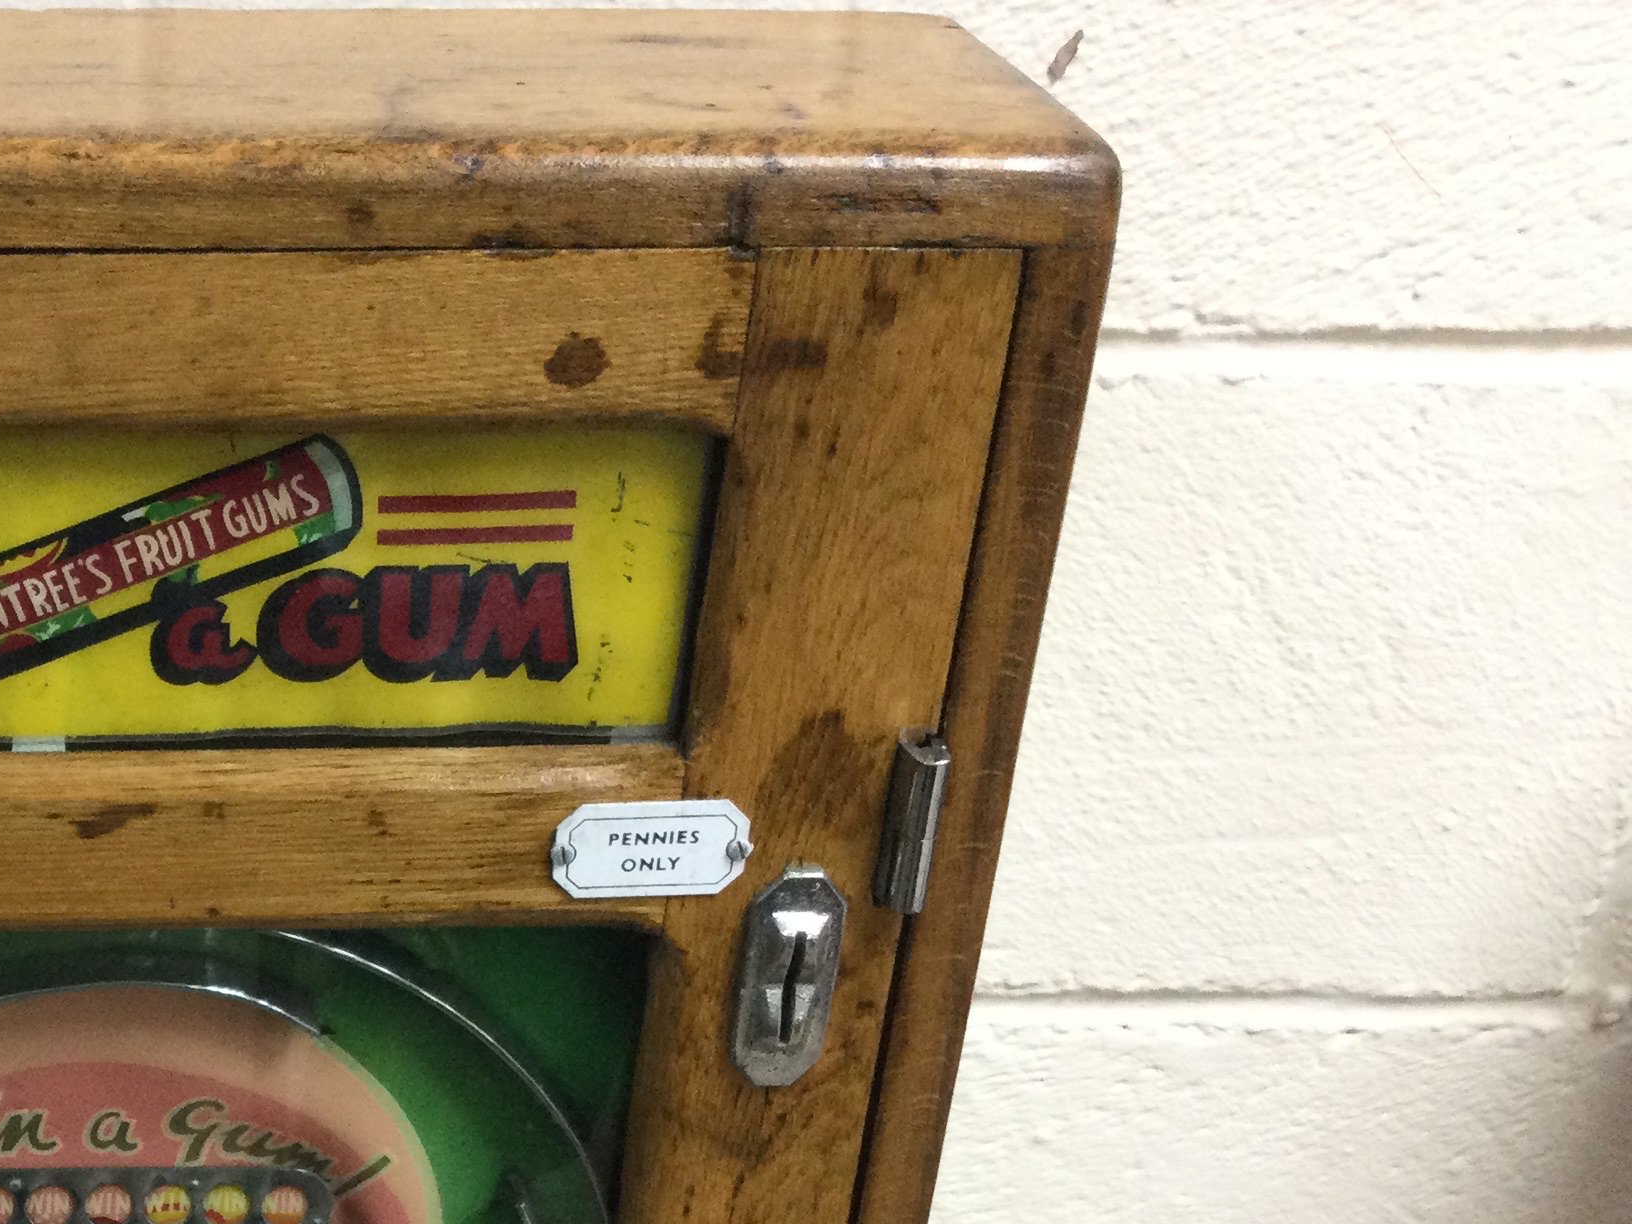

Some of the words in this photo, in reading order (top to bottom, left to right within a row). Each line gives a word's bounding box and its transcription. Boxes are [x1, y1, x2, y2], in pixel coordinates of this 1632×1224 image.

[112, 505, 218, 585] FRUIT
[222, 472, 321, 540] GUMS
[257, 562, 577, 683] GUM
[608, 829, 701, 847] PENNIES
[620, 856, 681, 873] ONLY
[89, 1110, 139, 1152] a
